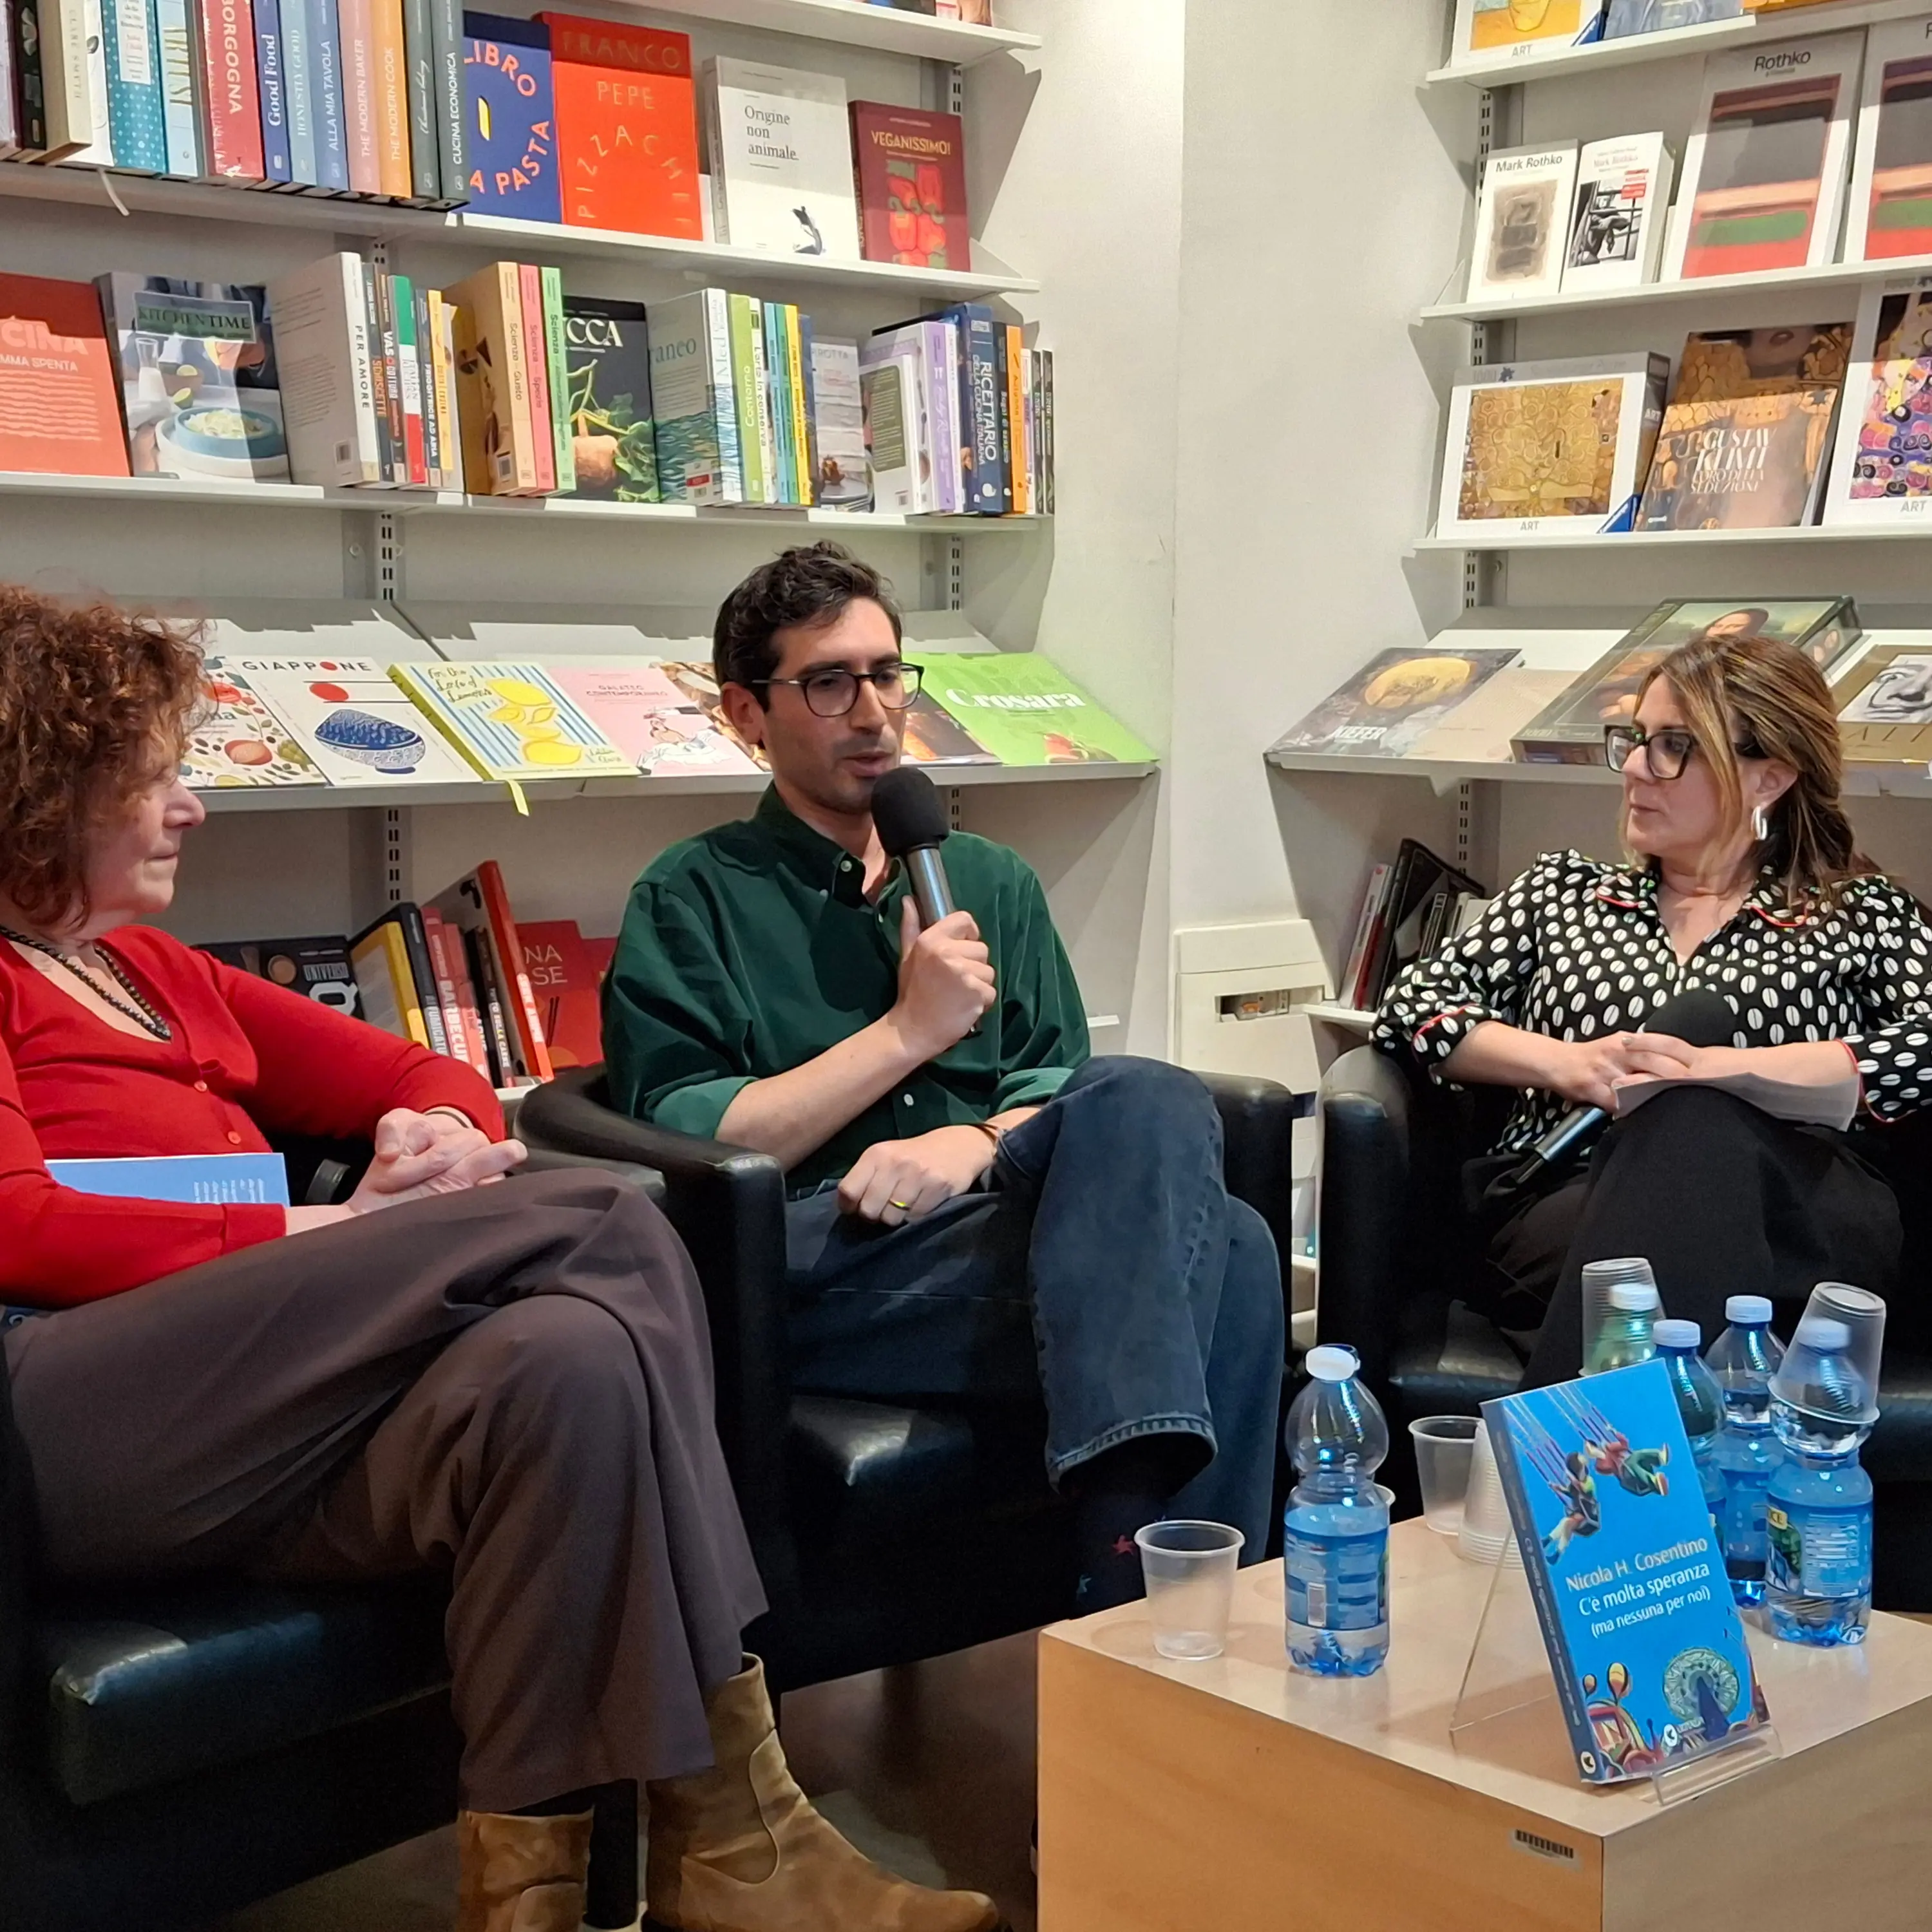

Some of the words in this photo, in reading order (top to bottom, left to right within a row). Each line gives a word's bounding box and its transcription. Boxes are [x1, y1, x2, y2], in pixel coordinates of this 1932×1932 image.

[261, 34, 277, 75] Food
[321, 41, 334, 91] TAVOLA
[354, 39, 365, 77] BAKER
[384, 47, 395, 82] COOK
[563, 32, 681, 69] FRANCO
[1511, 44, 1533, 57] ART
[1754, 50, 1812, 72] Rothko
[265, 80, 281, 126] Good
[446, 52, 460, 120] ECONOMICA
[597, 80, 655, 110] PEPE
[324, 92, 336, 117] MIA
[356, 79, 370, 132] MODERN
[388, 84, 399, 132] MODERN
[744, 105, 791, 126] Origine
[325, 118, 339, 151] ALLA
[359, 134, 371, 157] THE
[389, 135, 401, 160] THE
[450, 122, 462, 165] CUCINA
[746, 125, 770, 139] non
[871, 130, 951, 155] VEGANISSIMO!
[496, 120, 550, 195] PASTA
[1495, 158, 1523, 173] Mark
[1525, 154, 1563, 169] Rothko
[354, 325, 365, 352] PER
[509, 323, 519, 361] Scienza
[549, 314, 560, 355] Scienza
[563, 317, 623, 348] CCA
[32, 357, 79, 372] SPENTA
[648, 337, 697, 363] aneo
[713, 336, 730, 378] Med
[357, 357, 370, 408] AMORE
[972, 355, 981, 385] DELLA
[743, 365, 755, 427] Contorno
[980, 361, 997, 461] RICETTARIO
[1900, 500, 1927, 513] ART
[1520, 520, 1540, 531] ART
[945, 688, 1086, 710] Crosara
[1333, 725, 1388, 740] KIEFER
[1566, 1563, 1613, 1593] Nicola
[1634, 1537, 1709, 1572] Cosentino
[1578, 1595, 1601, 1616] C'è
[1603, 1580, 1645, 1609] molta
[1647, 1563, 1711, 1596] speranza
[1591, 1618, 1615, 1639] (ma
[1616, 1604, 1664, 1629] nessuna
[1665, 1596, 1685, 1616] per
[1685, 1585, 1712, 1605] noi)
